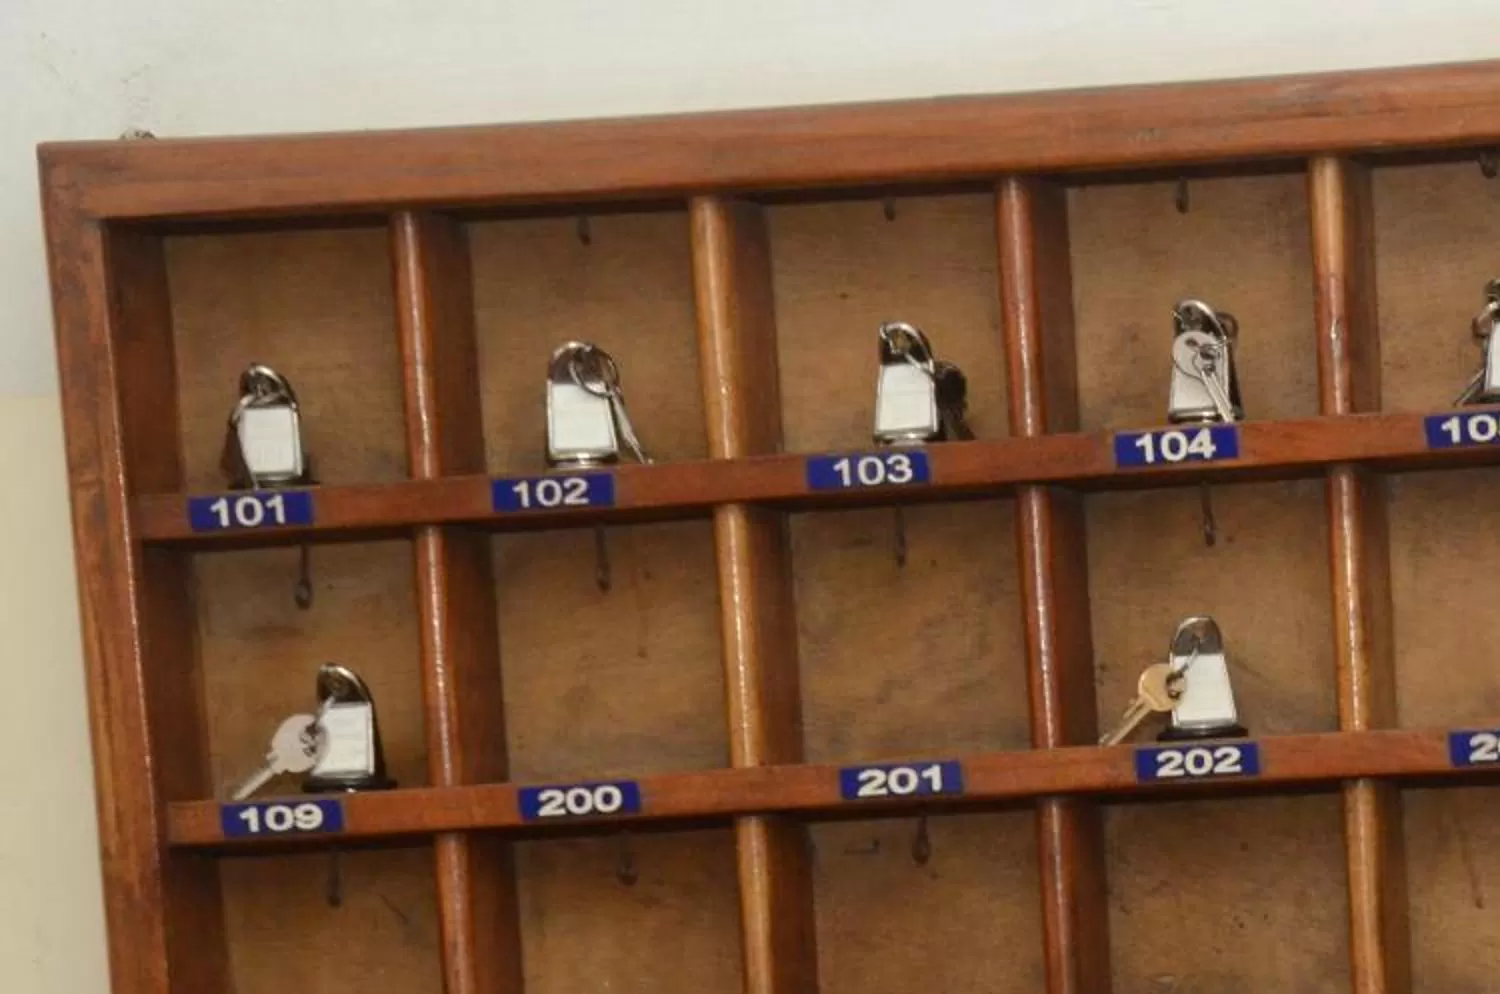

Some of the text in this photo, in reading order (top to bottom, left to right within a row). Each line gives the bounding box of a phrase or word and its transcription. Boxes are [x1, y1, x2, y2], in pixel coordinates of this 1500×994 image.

[1135, 427, 1217, 463] 104
[833, 453, 913, 486] 103
[512, 477, 589, 508] 102
[210, 494, 285, 527] 101
[1156, 746, 1242, 777] 202
[857, 764, 942, 797] 201
[538, 785, 622, 817] 200
[239, 803, 323, 833] 109
